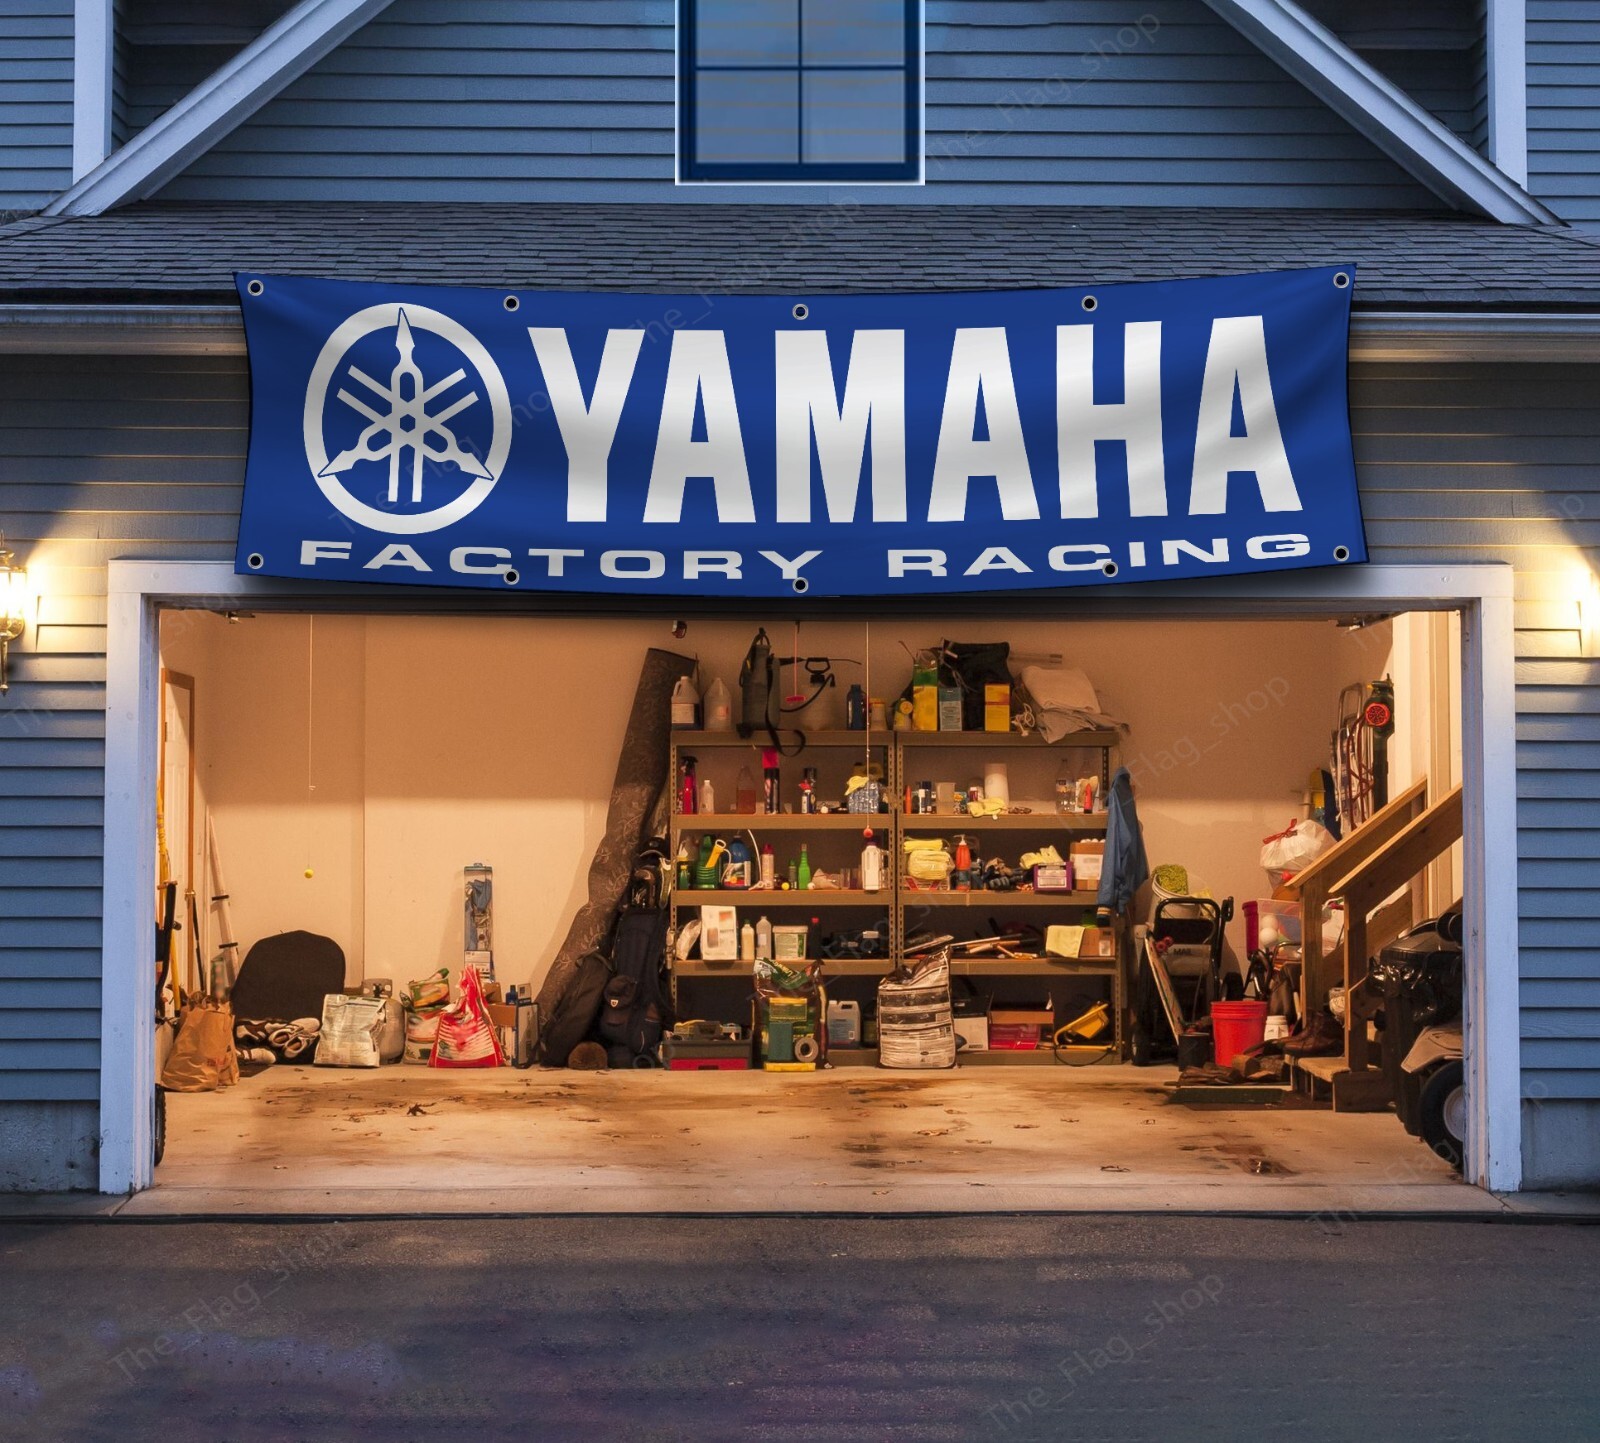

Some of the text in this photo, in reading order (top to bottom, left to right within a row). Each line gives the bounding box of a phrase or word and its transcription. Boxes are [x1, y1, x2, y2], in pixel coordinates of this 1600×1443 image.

[527, 315, 1303, 523] YAMAHA
[300, 533, 1311, 581] FACTORY RACING
